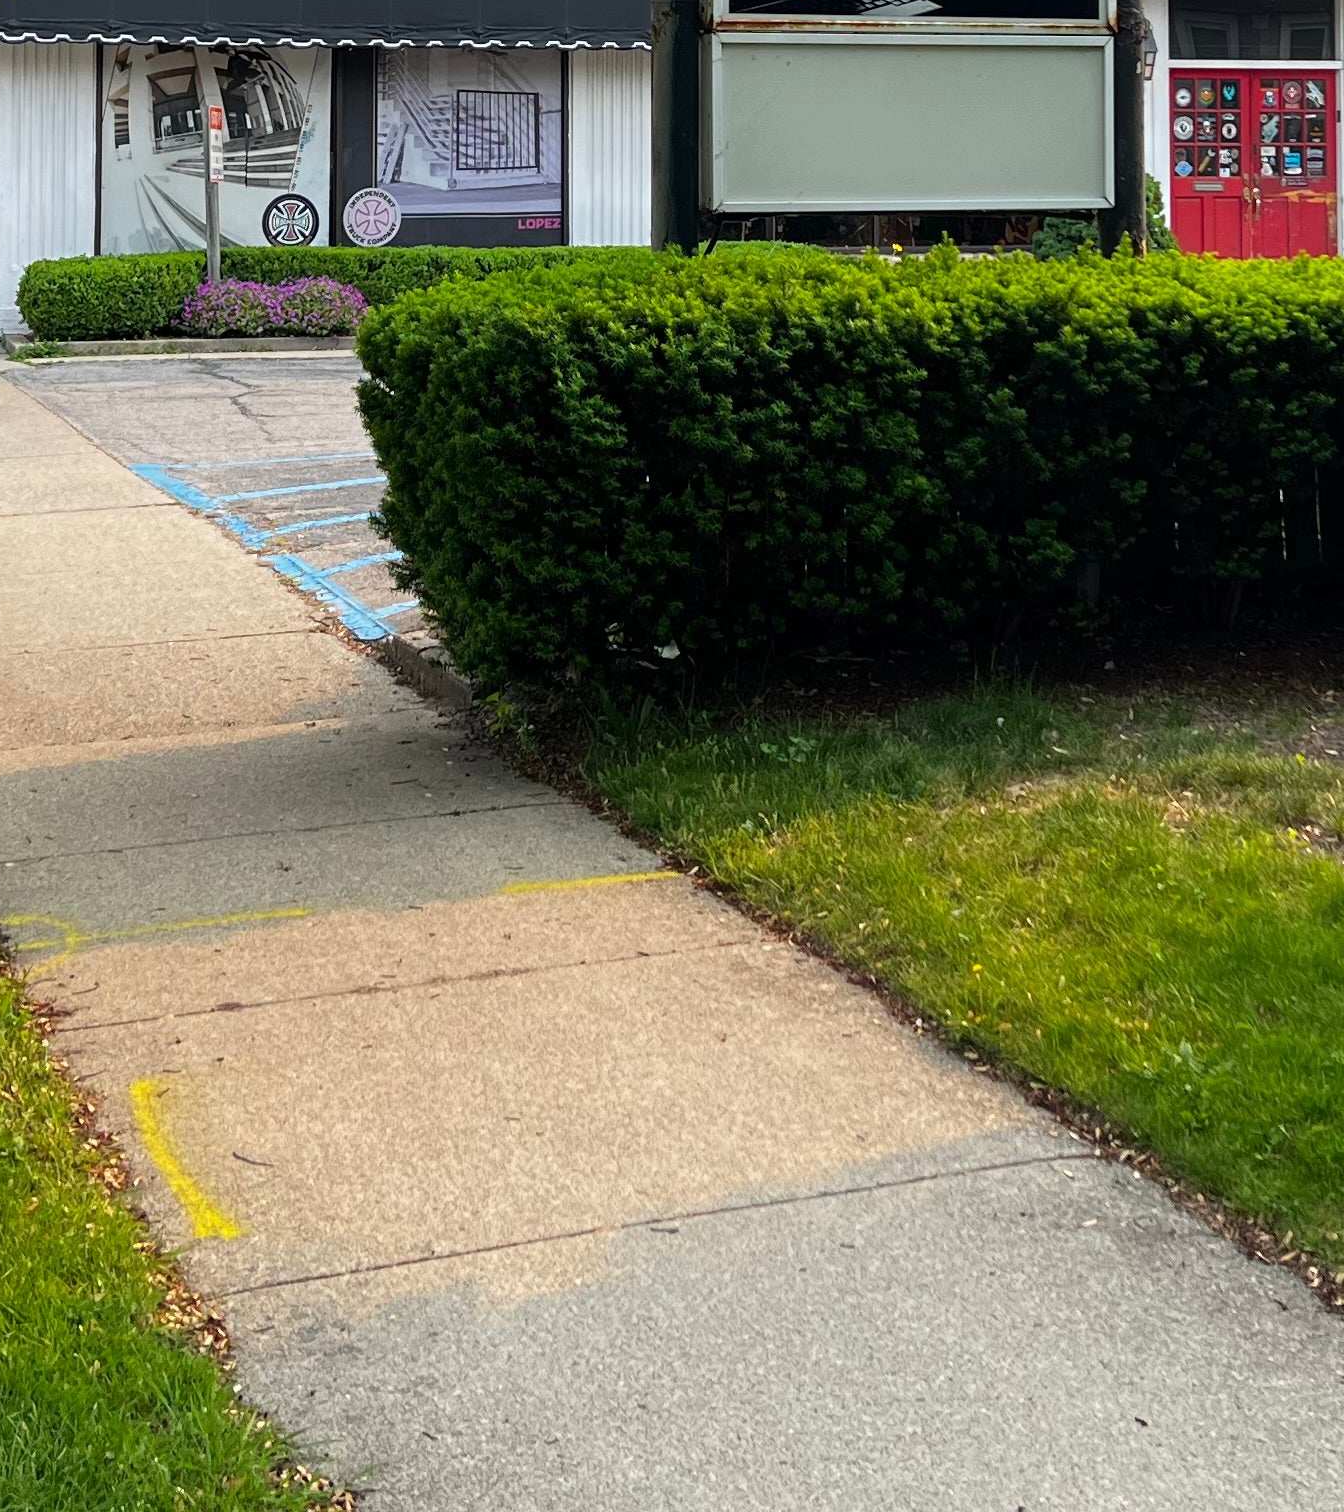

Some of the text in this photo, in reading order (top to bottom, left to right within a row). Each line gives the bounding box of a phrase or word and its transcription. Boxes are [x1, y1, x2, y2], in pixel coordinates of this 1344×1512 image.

[349, 190, 395, 209] INDEPENDENT
[518, 218, 561, 229] LOPEZ
[347, 222, 397, 245] TRUCK COMPANY
